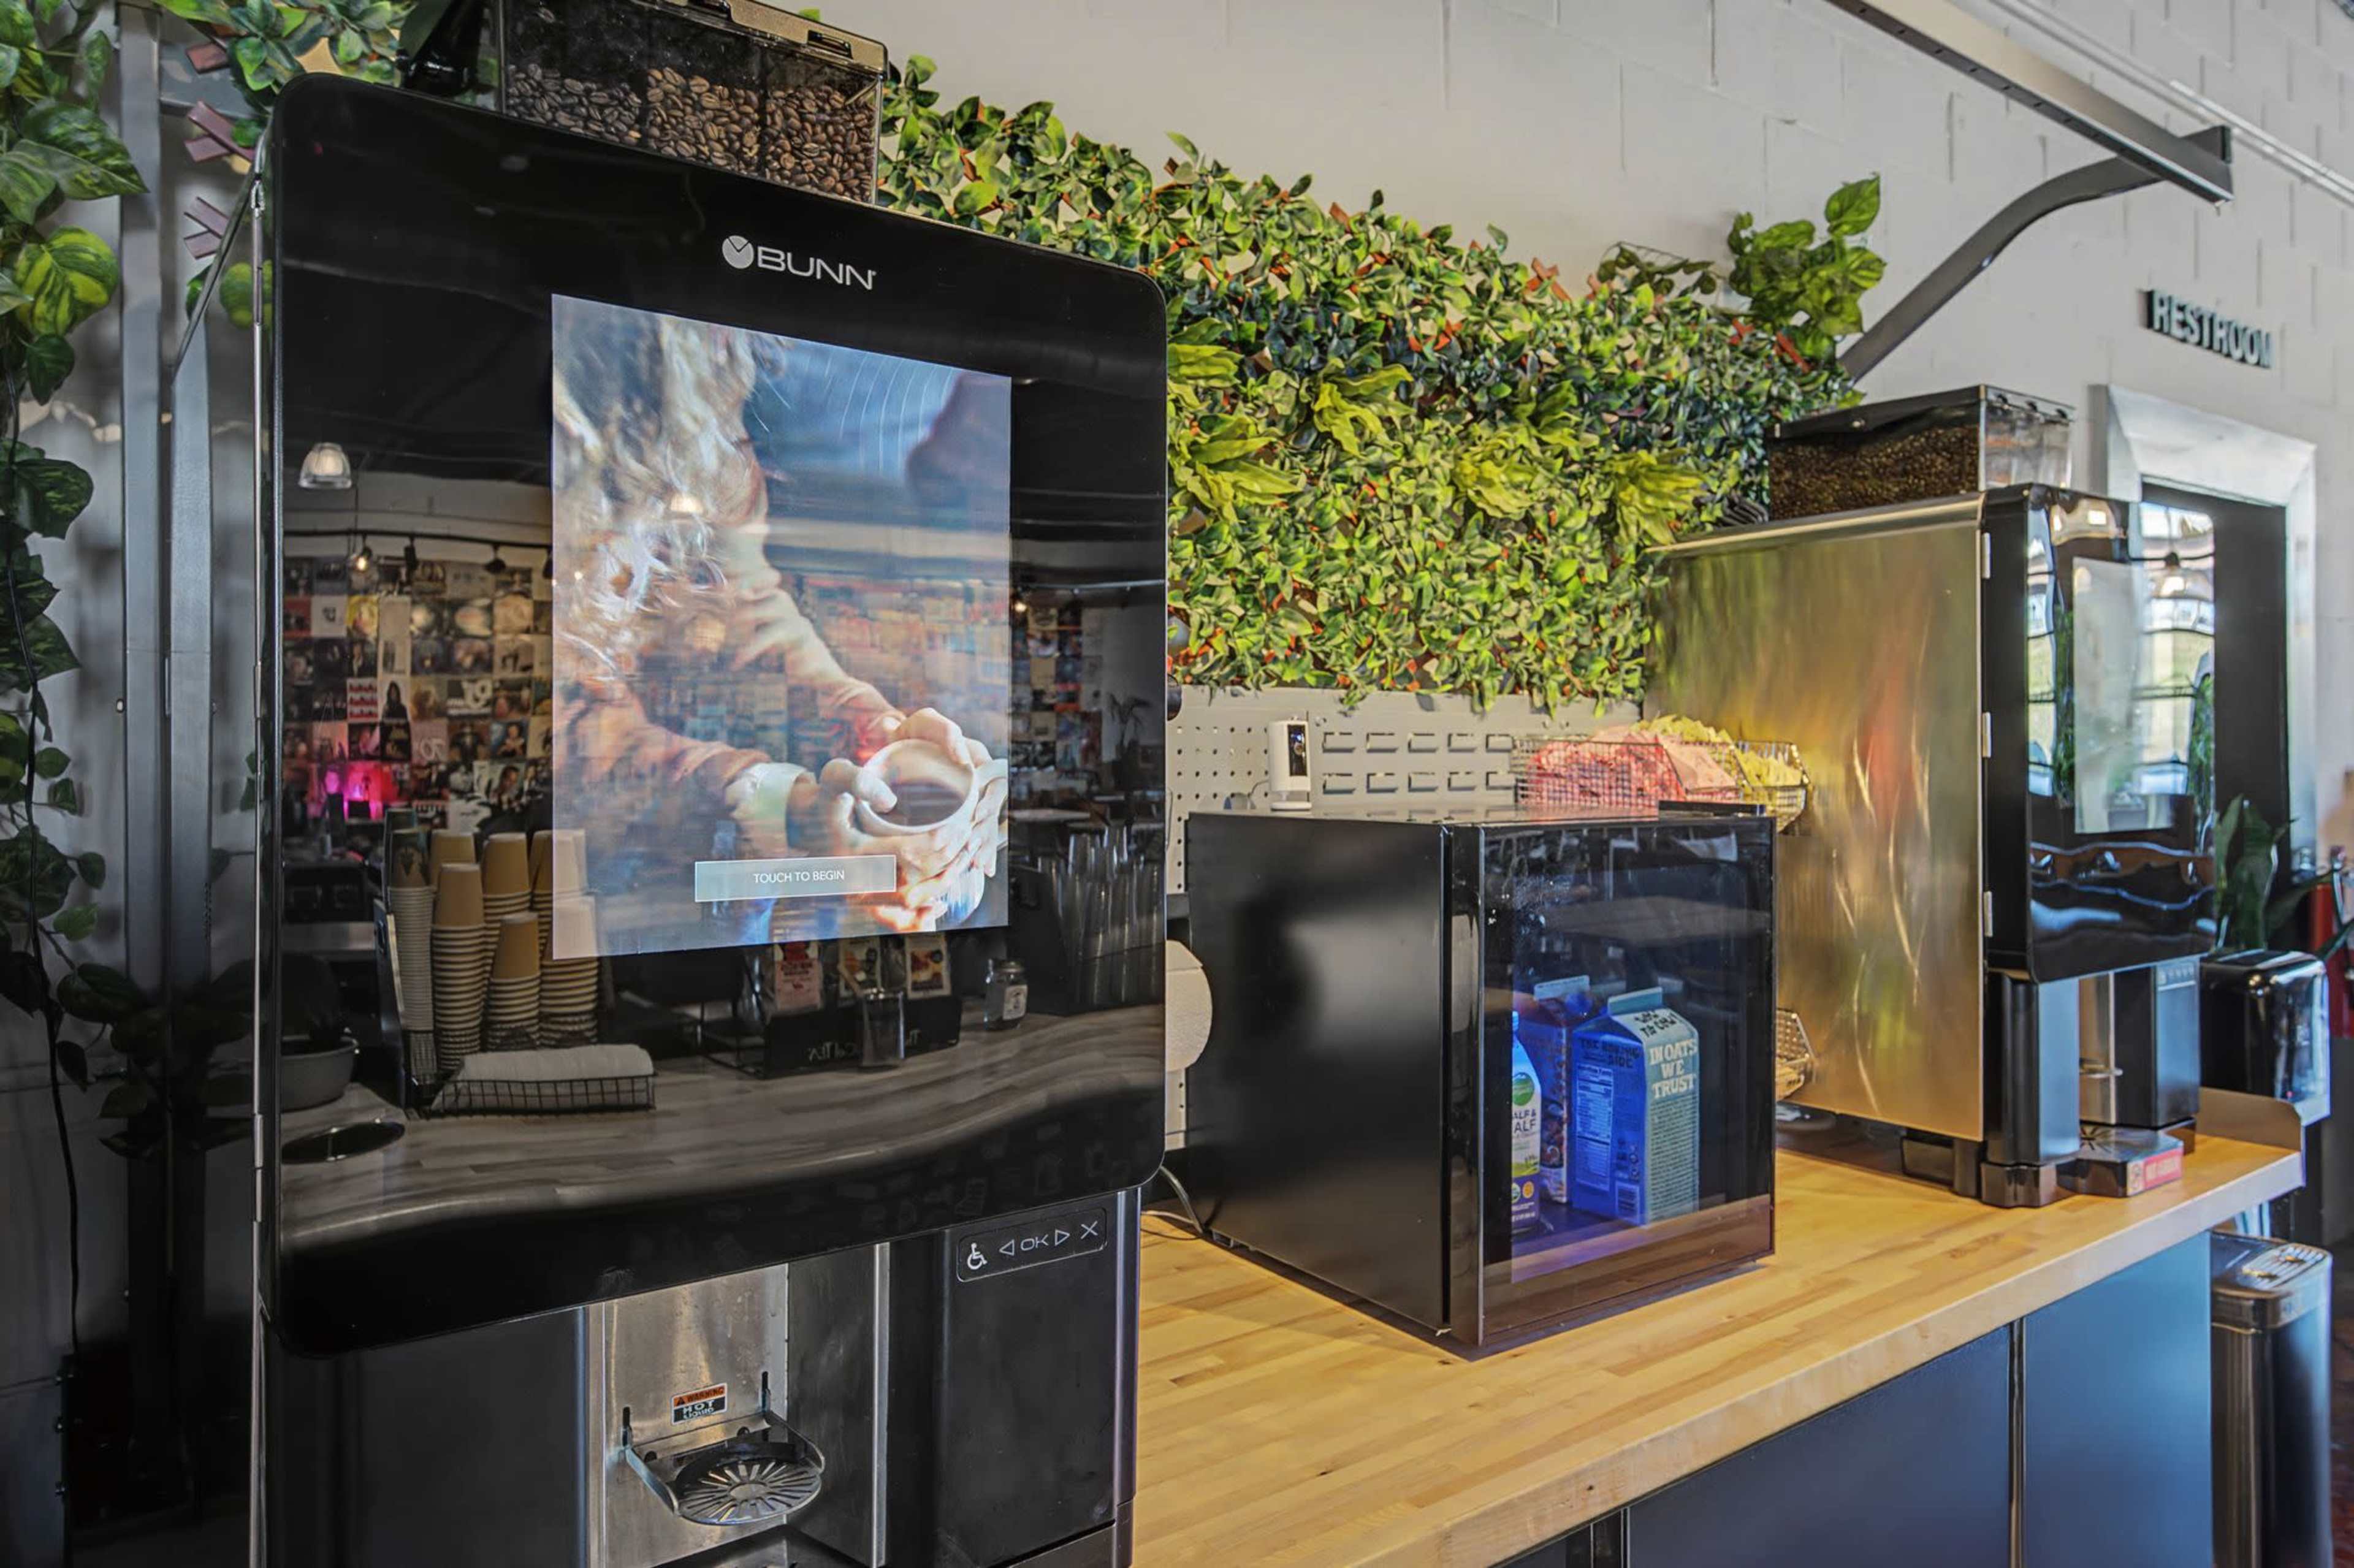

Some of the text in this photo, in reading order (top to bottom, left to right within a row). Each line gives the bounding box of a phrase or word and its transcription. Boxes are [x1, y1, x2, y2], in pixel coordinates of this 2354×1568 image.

[758, 246, 872, 290] BUNN
[753, 869, 845, 884] TOUCH TO BEGIN
[1664, 1038, 1697, 1062] OATS
[1661, 1059, 1685, 1079] WE
[1652, 1073, 1694, 1098] TRUST
[1020, 1235, 1049, 1251] OK
[687, 1387, 725, 1403] WARNING
[682, 1399, 715, 1414] HOT
